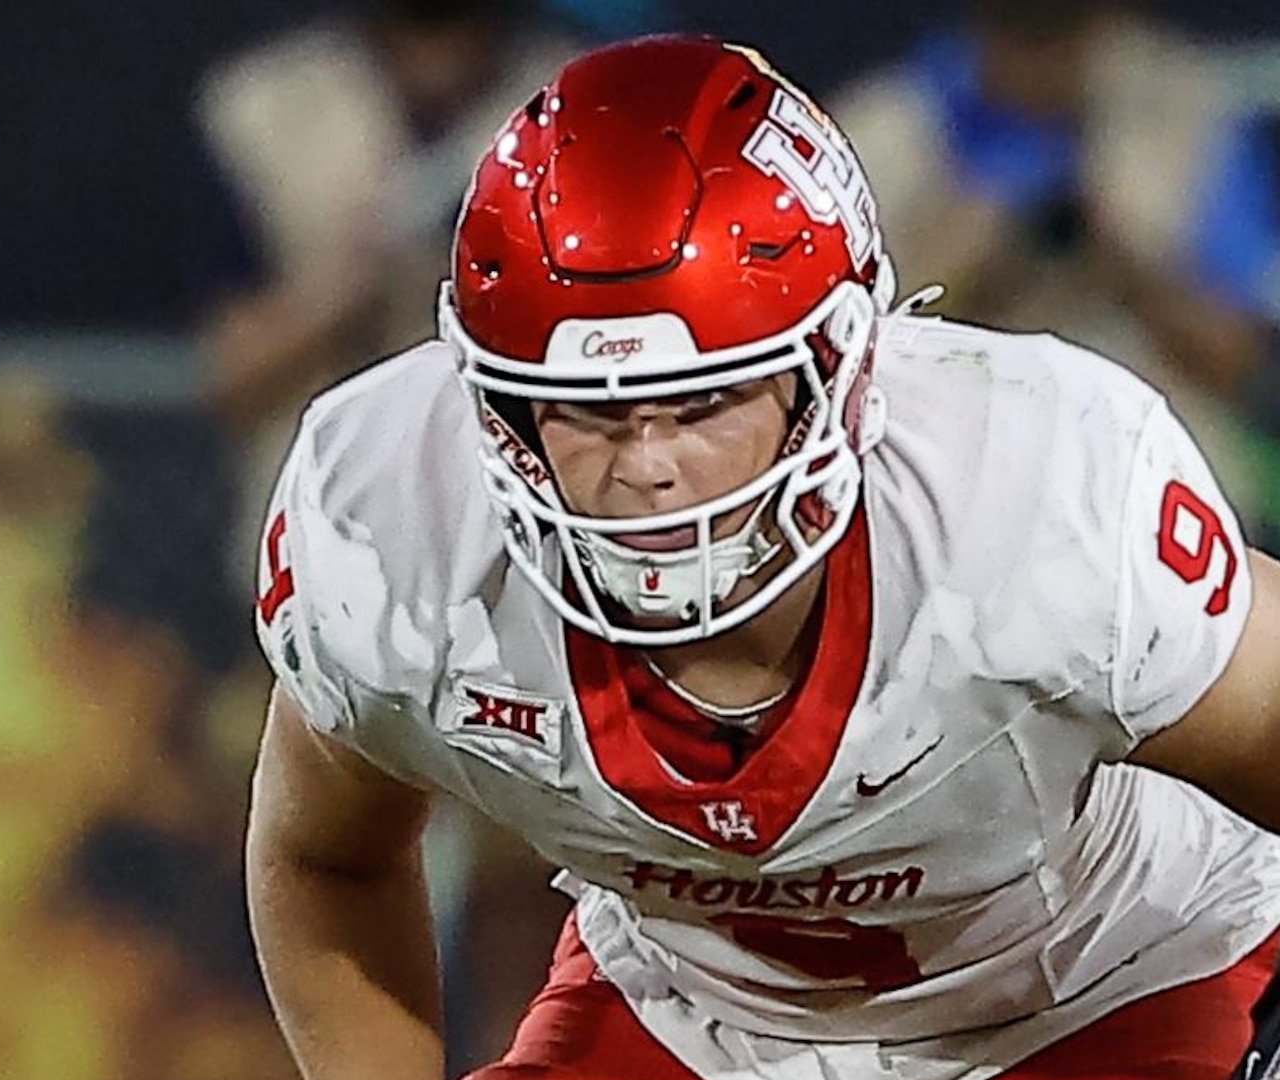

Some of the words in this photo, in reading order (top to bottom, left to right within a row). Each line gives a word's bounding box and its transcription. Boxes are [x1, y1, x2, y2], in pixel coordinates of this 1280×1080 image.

[1157, 480, 1237, 617] 9
[462, 687, 547, 745] XII
[623, 860, 925, 909] Houston
